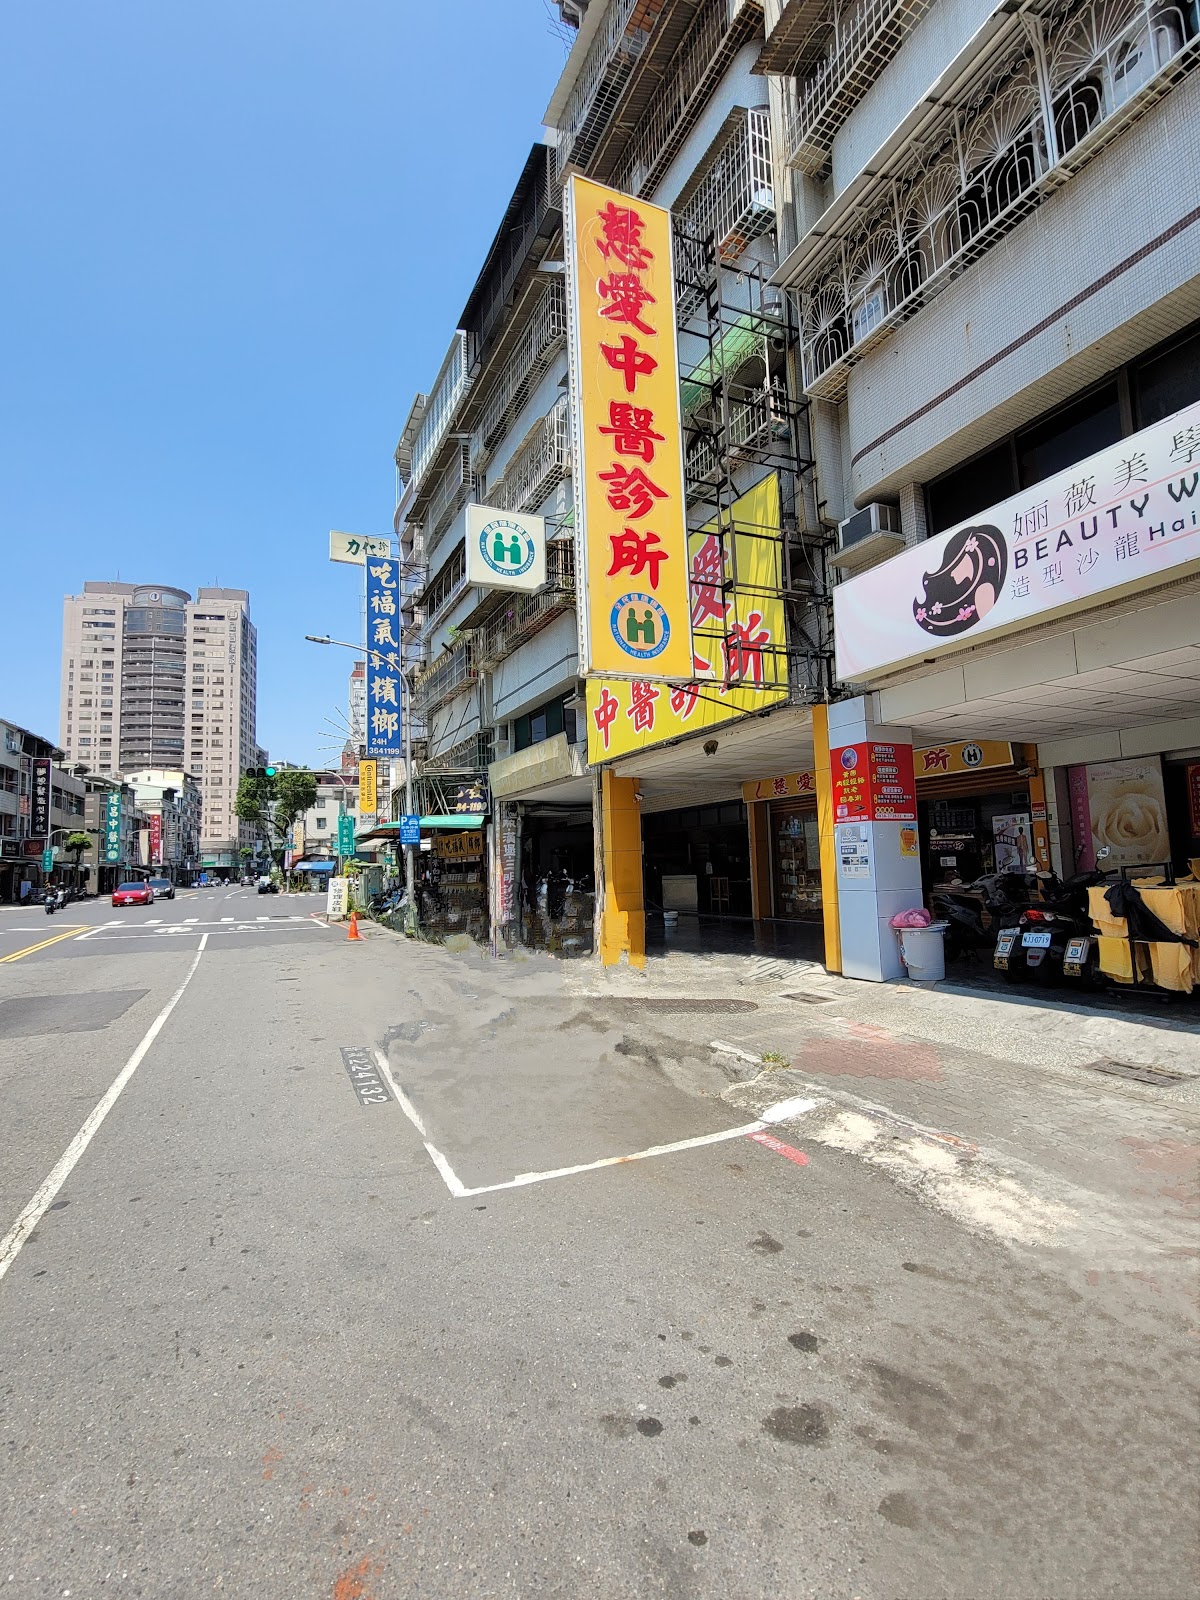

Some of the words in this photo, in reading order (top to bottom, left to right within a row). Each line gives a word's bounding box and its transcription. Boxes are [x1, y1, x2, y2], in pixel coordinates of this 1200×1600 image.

[597, 200, 672, 591] 慈愛中醫診所
[1014, 493, 1150, 570] BEAUTY
[495, 566, 516, 576] HEALTH
[1010, 531, 1141, 600] 造型沙龍
[369, 561, 399, 648] 吃福氣
[611, 623, 628, 652] NATIONAL
[629, 648, 651, 659] HEALTH
[651, 630, 670, 656] INSURANCE
[369, 675, 399, 740] 檳榔
[371, 737, 388, 746] 24H
[921, 748, 951, 772] 所
[772, 772, 816, 796] 慈愛
[108, 794, 120, 843] 建昌中醫
[400, 816, 408, 826] P
